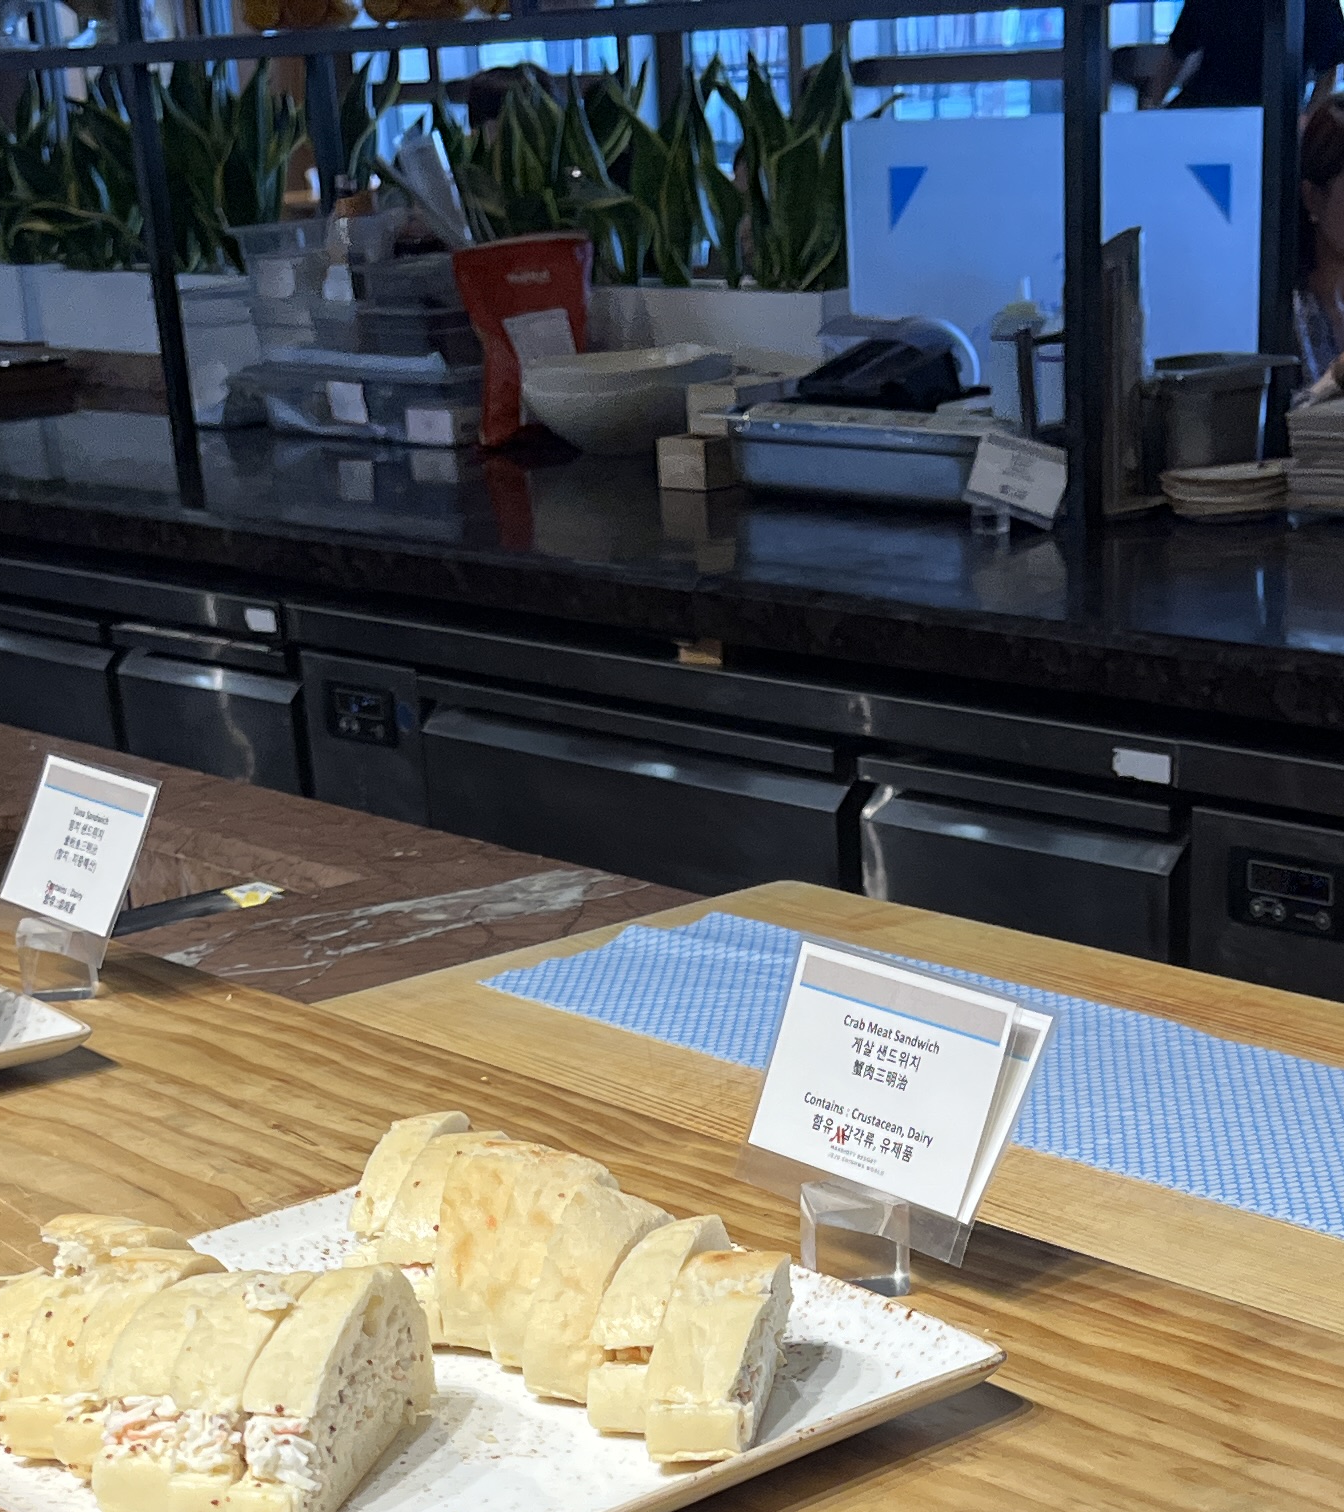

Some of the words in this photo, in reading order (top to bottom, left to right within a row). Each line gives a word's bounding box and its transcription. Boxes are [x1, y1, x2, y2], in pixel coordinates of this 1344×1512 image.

[843, 1014, 866, 1030] Crab
[867, 1021, 893, 1039] Meat
[893, 1029, 940, 1054] Sandwich
[851, 1036, 875, 1057] 게살
[876, 1044, 922, 1072] 샌드위치
[804, 1091, 844, 1115] Contains
[851, 1107, 905, 1139] Crustacean,
[907, 1126, 933, 1148] Dairy
[811, 1113, 834, 1135] 함유
[879, 1137, 914, 1163] 유제품
